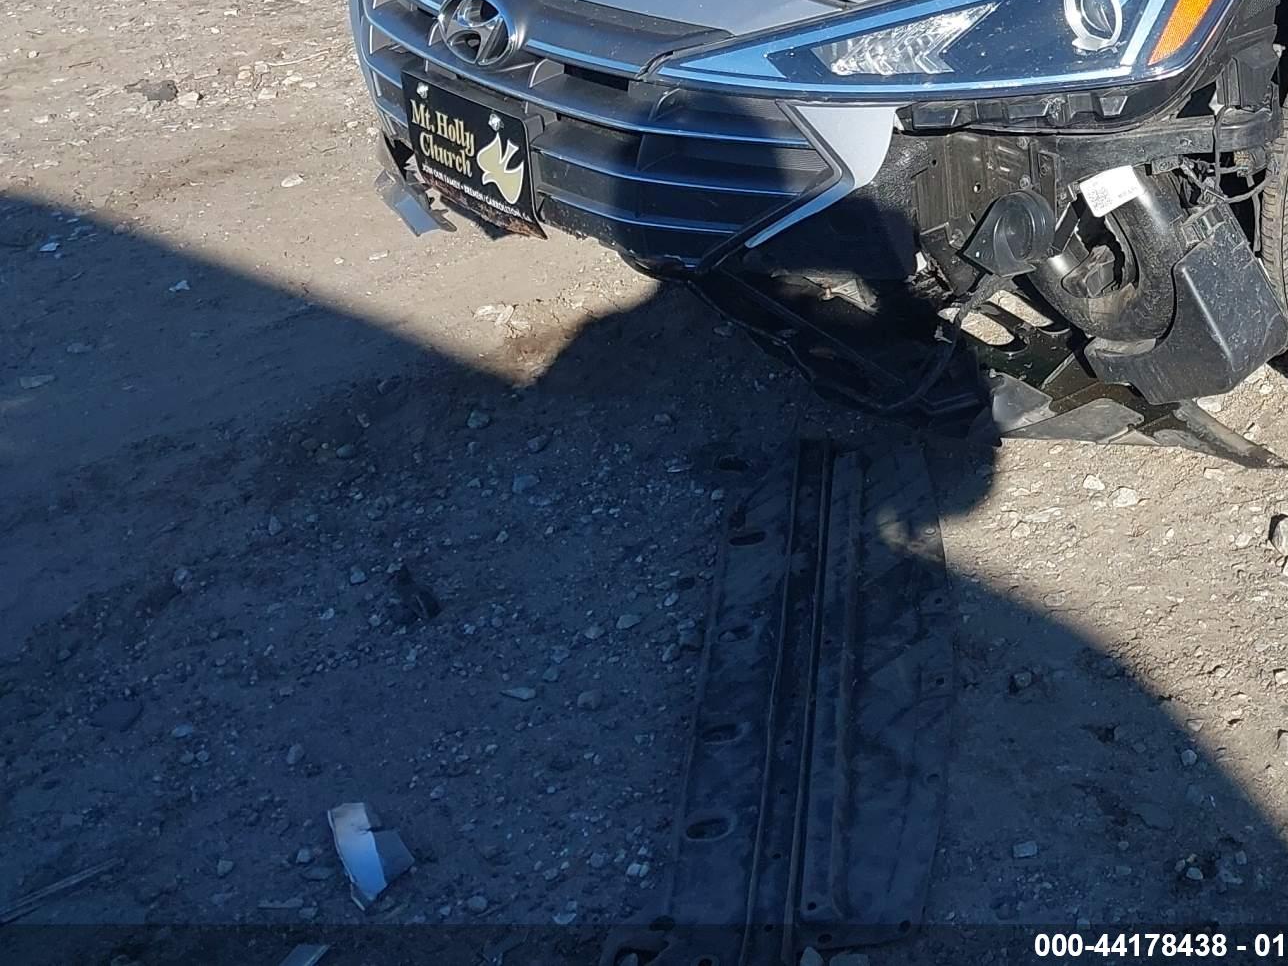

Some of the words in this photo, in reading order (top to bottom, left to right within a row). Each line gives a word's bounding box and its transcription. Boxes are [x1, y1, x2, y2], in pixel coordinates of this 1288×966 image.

[409, 98, 435, 133] Mt.
[435, 110, 475, 158] Holly
[419, 131, 473, 178] Church
